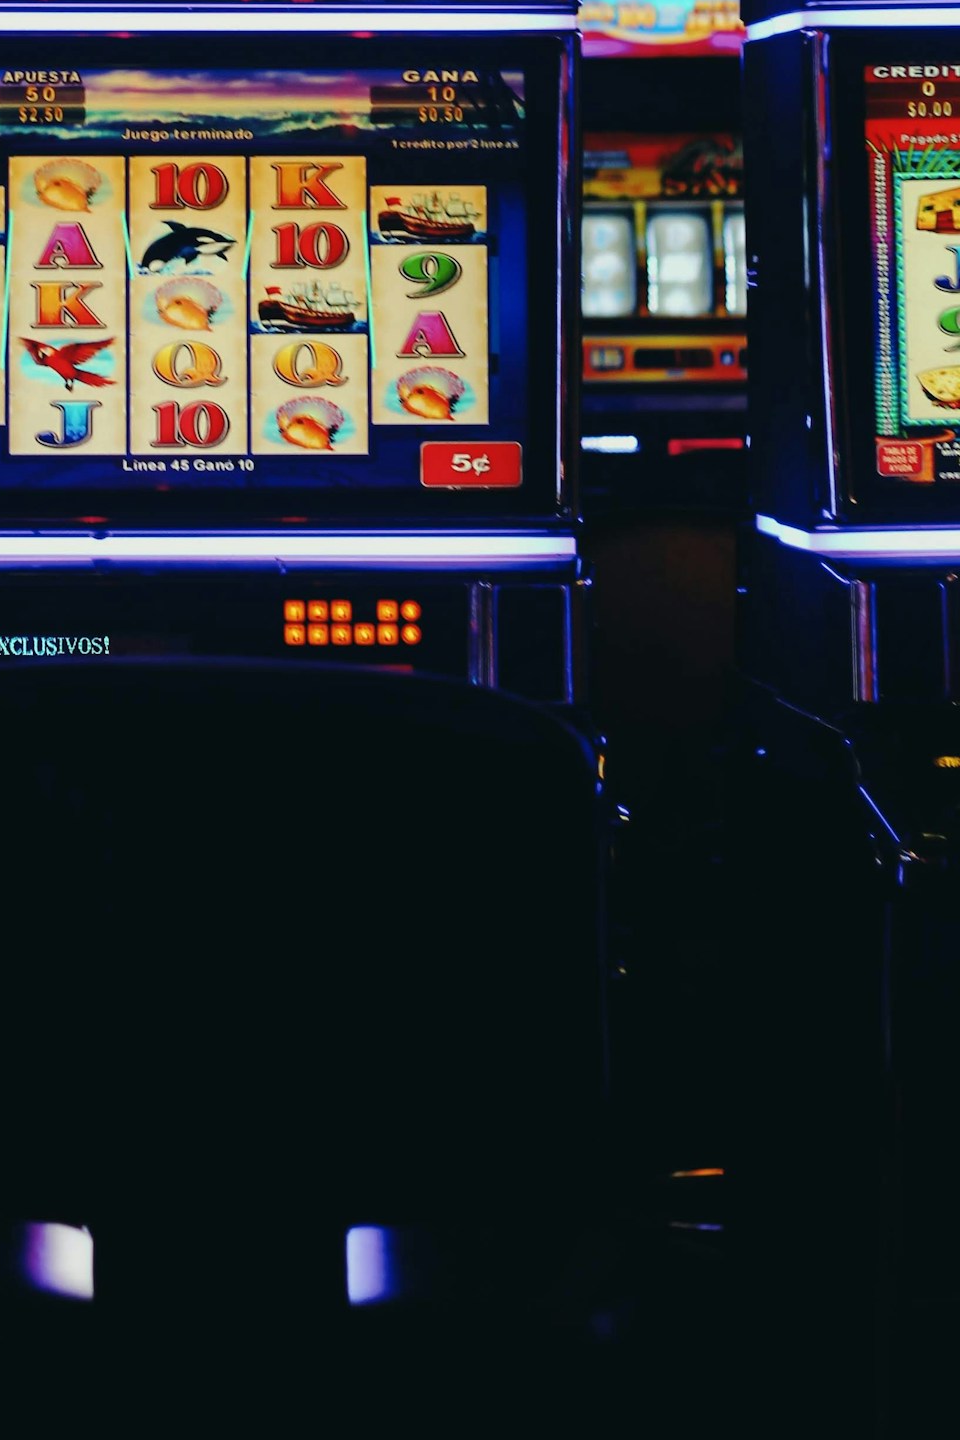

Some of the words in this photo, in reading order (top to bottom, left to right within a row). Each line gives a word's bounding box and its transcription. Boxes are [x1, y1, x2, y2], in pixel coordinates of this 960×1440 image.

[2, 71, 82, 84] APUESTA
[402, 70, 479, 83] GANA
[25, 86, 57, 103] 50
[427, 86, 456, 102] 10
[922, 81, 936, 97] 0
[18, 106, 64, 123] $2.50
[417, 105, 464, 123] $0.50
[907, 101, 952, 118] $0.00
[121, 128, 170, 143] Juego
[173, 127, 254, 140] terminado
[446, 140, 469, 150] por
[900, 134, 949, 145] Pagado
[150, 162, 230, 211] 10
[271, 161, 348, 211] K
[40, 221, 104, 270] A
[270, 220, 350, 270] 10
[398, 250, 463, 299] 9
[30, 281, 107, 329] K
[397, 311, 467, 359] A
[151, 340, 229, 389] Q
[272, 340, 350, 389] Q
[34, 399, 103, 448] J
[151, 400, 230, 448] 10
[170, 459, 191, 471] 45
[238, 459, 256, 471] 10
[450, 453, 491, 476] 5¢
